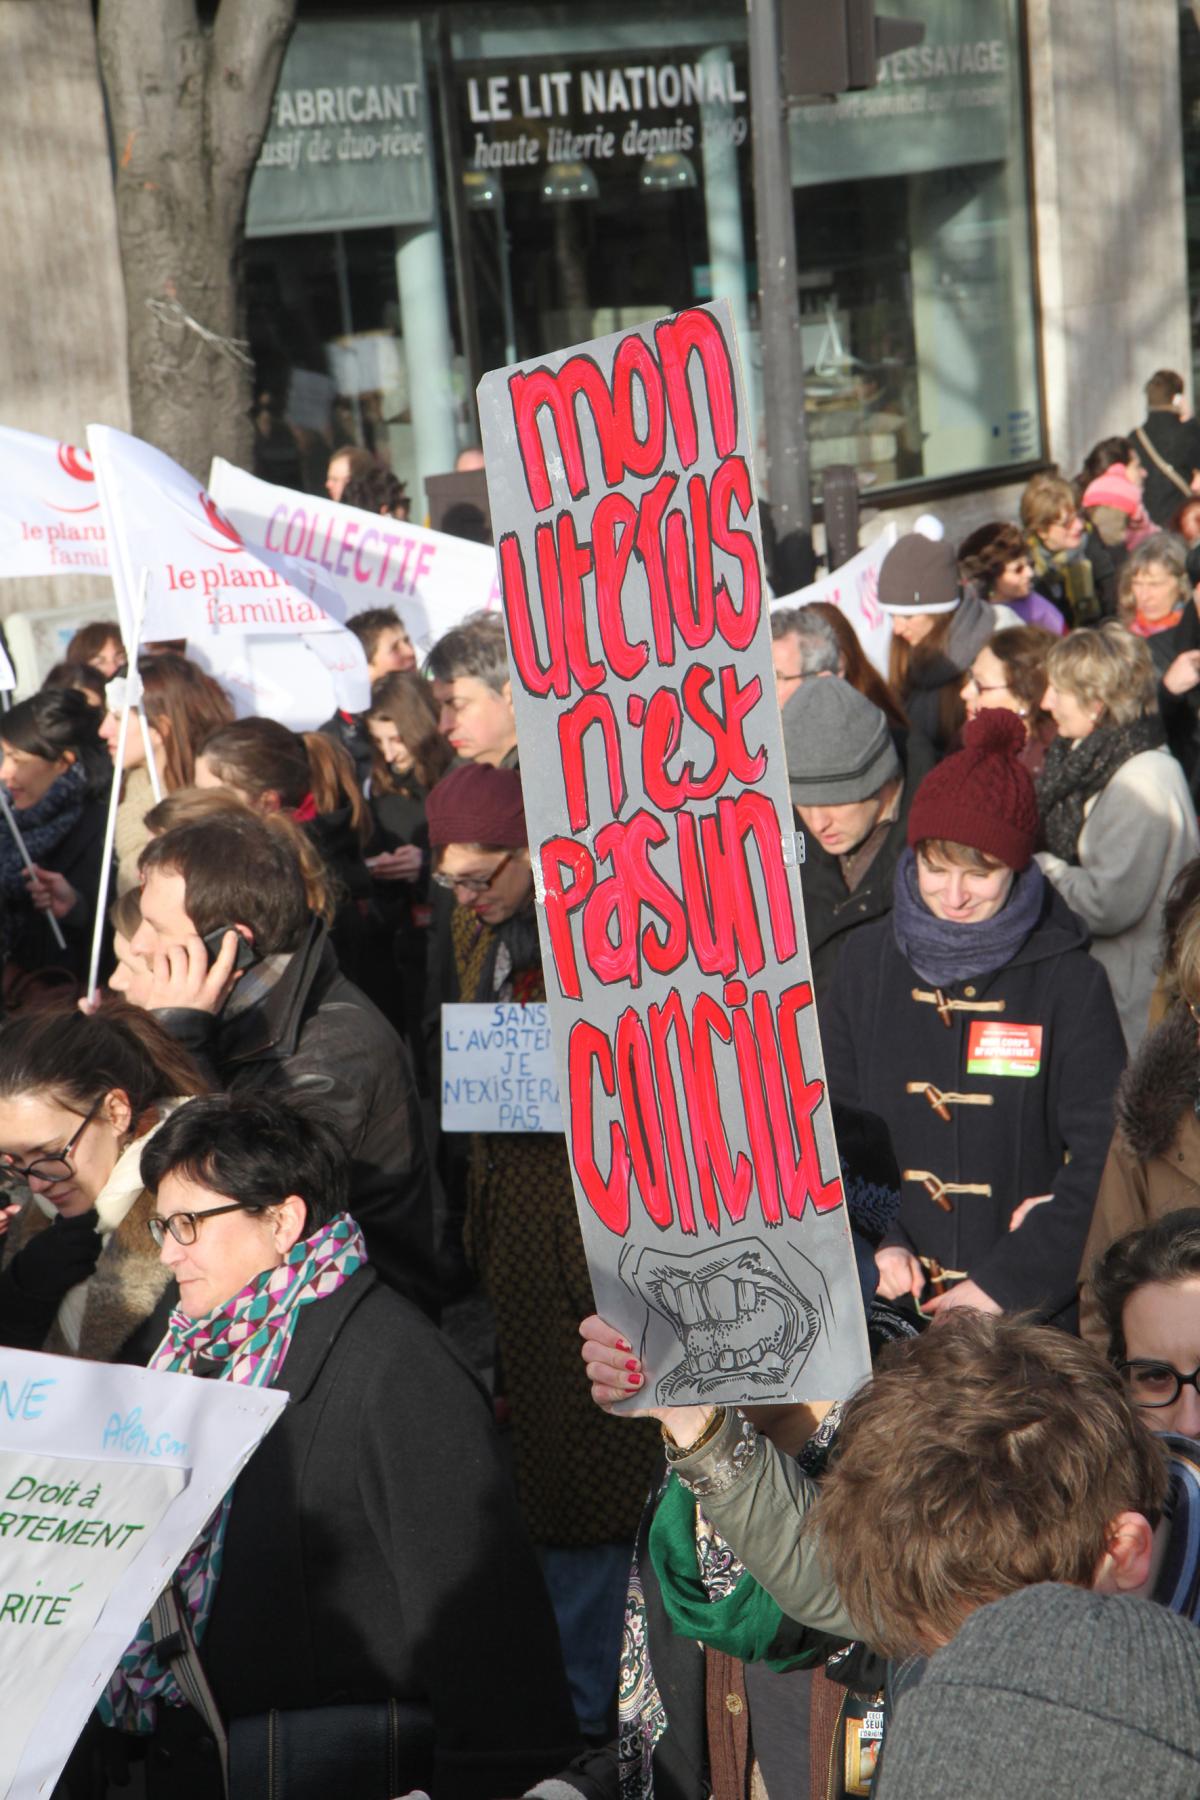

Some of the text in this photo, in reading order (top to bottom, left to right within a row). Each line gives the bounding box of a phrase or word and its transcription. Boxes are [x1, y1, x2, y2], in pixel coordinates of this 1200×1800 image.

[271, 82, 418, 127] ABRICANT
[467, 77, 512, 122] LE
[519, 71, 571, 118] LIT
[580, 60, 747, 115] NATIONAL
[305, 130, 331, 162] de
[473, 132, 540, 169] haute
[546, 125, 616, 163] literie
[621, 117, 694, 162] depuis
[508, 307, 737, 513] mon
[264, 503, 437, 596] COLLECTIF
[166, 564, 196, 590] le
[556, 663, 768, 835] n'est
[491, 1004, 547, 1027] SANS
[502, 1052, 532, 1076] JE
[5, 1476, 103, 1510] Droit à
